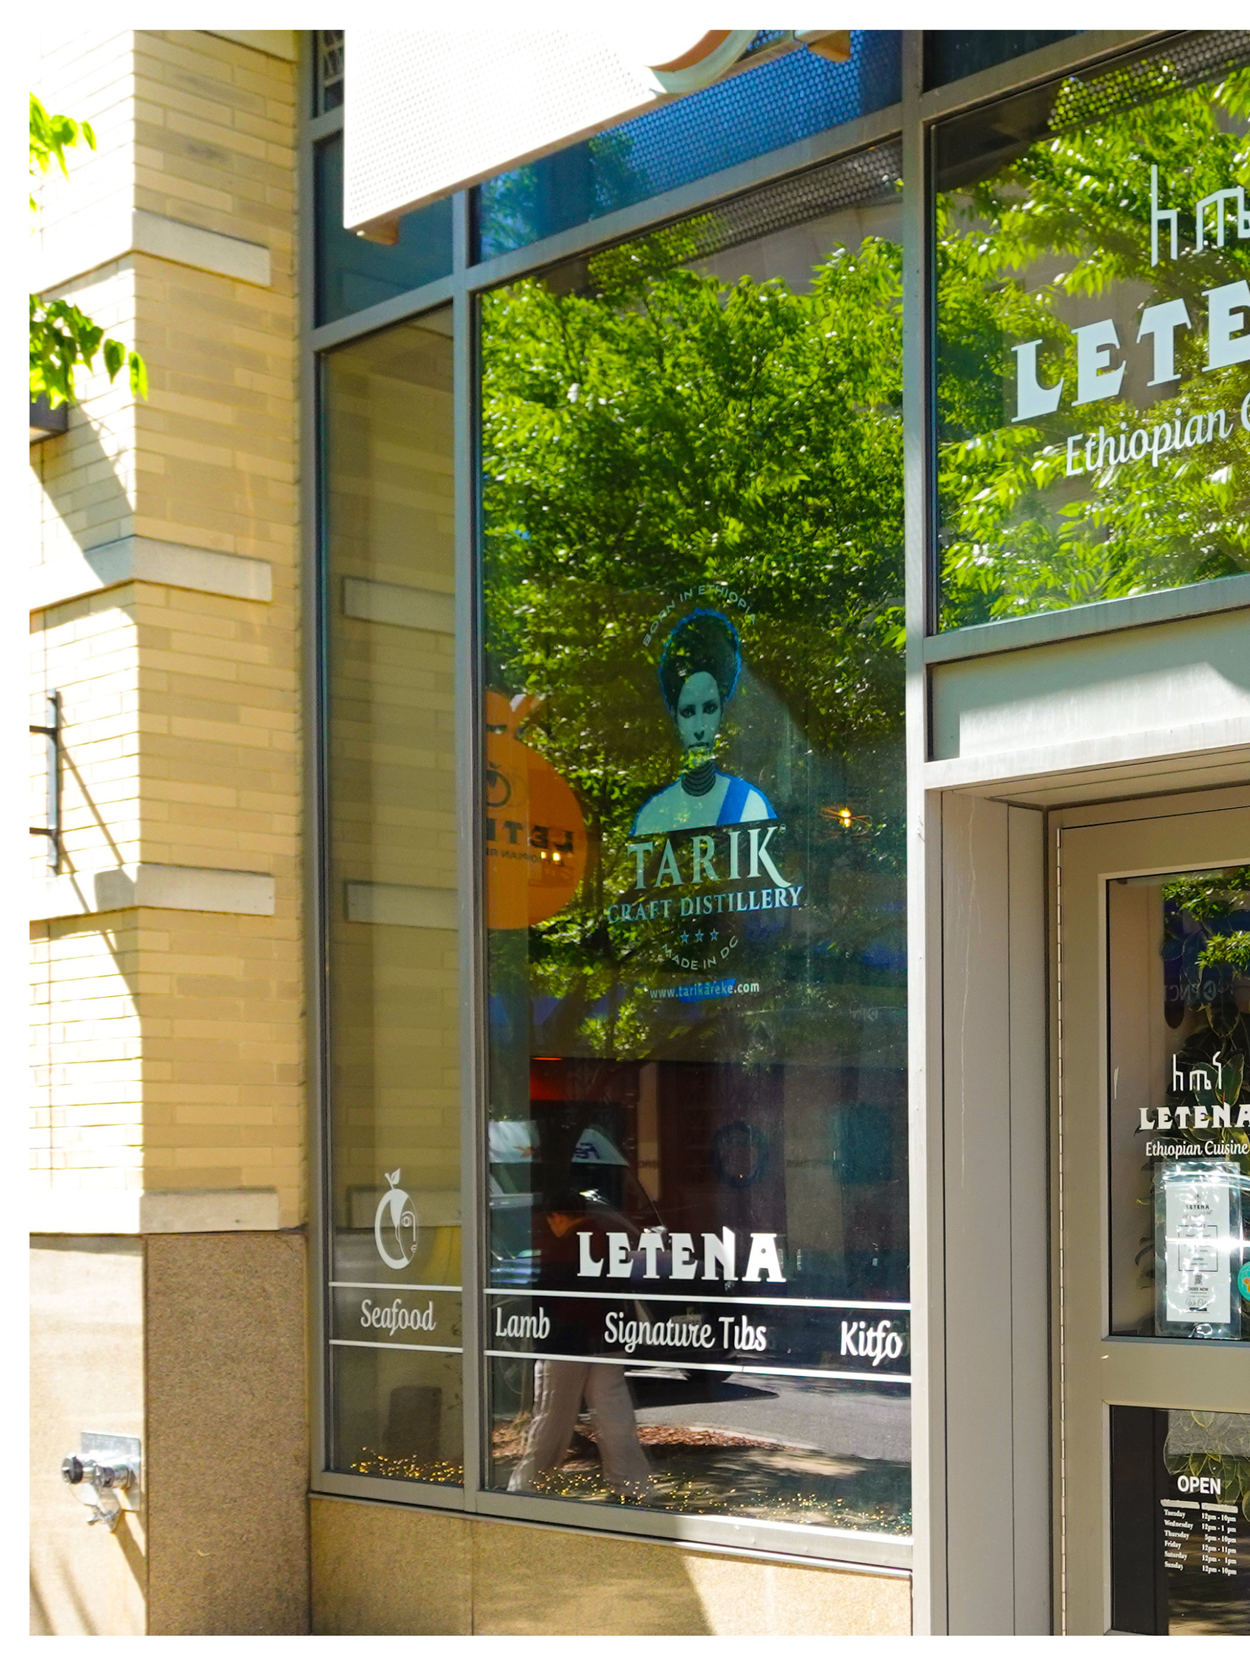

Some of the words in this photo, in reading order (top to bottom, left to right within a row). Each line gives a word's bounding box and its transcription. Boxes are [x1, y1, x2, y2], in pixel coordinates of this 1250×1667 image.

[1065, 408, 1233, 477] Ethiopian
[627, 826, 792, 890] TARIK
[607, 899, 672, 924] CRAFT
[680, 886, 804, 917] DISTILLERY
[662, 943, 699, 970] MADE
[703, 956, 716, 969] IN
[720, 935, 739, 959] DC
[1146, 1141, 1203, 1159] Ethiopian
[1204, 1140, 1250, 1155] Cuisine
[577, 1226, 786, 1282] LETENA
[360, 1299, 437, 1336] Seafood
[495, 1307, 550, 1339] Lamb
[604, 1312, 715, 1353] Signature
[840, 1320, 902, 1366] Kitfo
[1177, 1475, 1221, 1495] OPEN
[1164, 1509, 1186, 1519] Tuesday
[1201, 1513, 1217, 1522] 12pm
[1221, 1515, 1237, 1524] 10pm
[1164, 1519, 1194, 1530] Wednesday
[1201, 1523, 1217, 1532] 12pm
[1164, 1530, 1190, 1540] Thursday
[1204, 1534, 1217, 1543] 5pm
[1221, 1535, 1237, 1545] 10pm
[1164, 1540, 1181, 1550] Friday
[1202, 1544, 1217, 1553] 12pm
[1222, 1546, 1237, 1555] 11pm
[1164, 1550, 1188, 1561] Saturday
[1202, 1554, 1217, 1563] 12pm
[1164, 1561, 1184, 1571] Sunday
[1202, 1565, 1217, 1574] 12pm
[1222, 1567, 1237, 1576] 10pm
